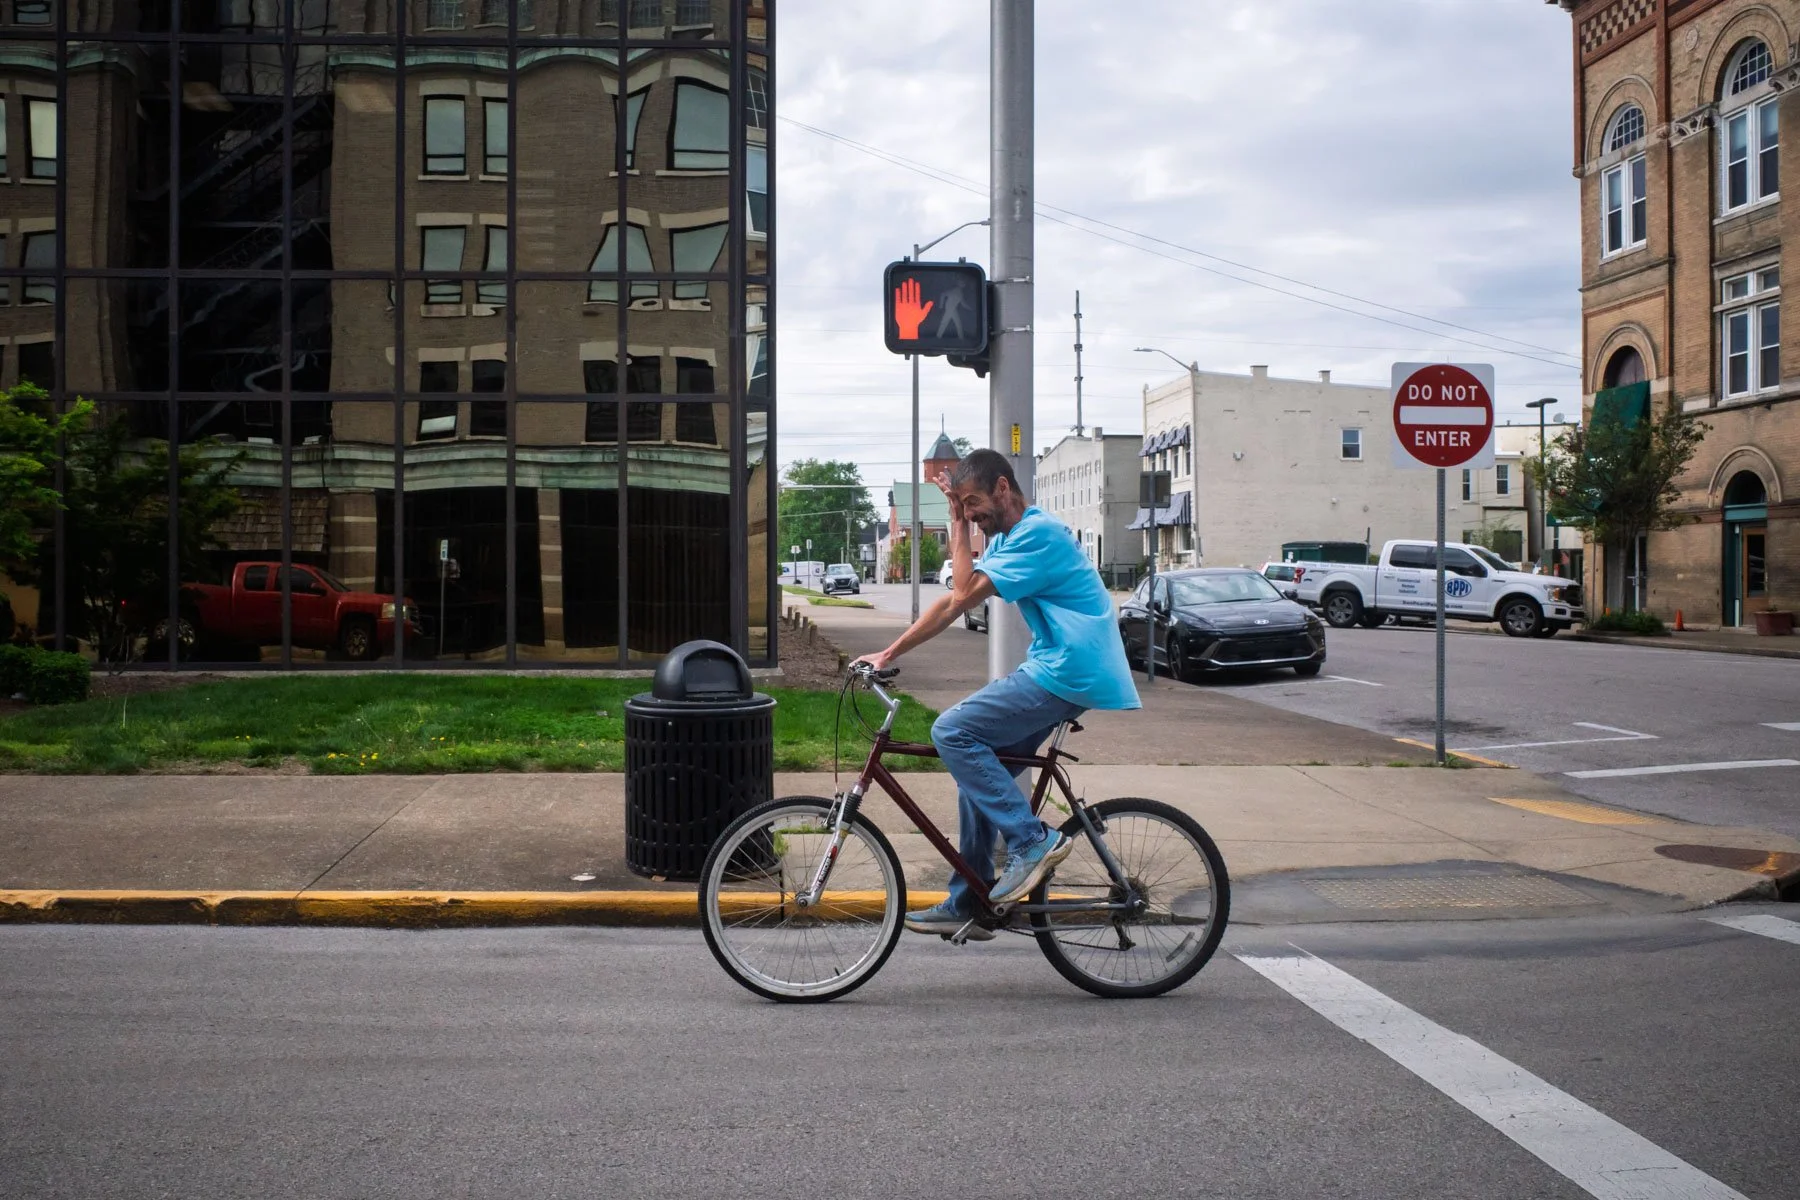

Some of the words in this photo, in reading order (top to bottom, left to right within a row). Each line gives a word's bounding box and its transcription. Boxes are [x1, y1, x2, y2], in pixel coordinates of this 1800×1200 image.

[1408, 384, 1432, 400] DO
[1441, 385, 1478, 401] NOT
[1415, 430, 1471, 447] ENTER
[1446, 580, 1468, 596] BPPI
